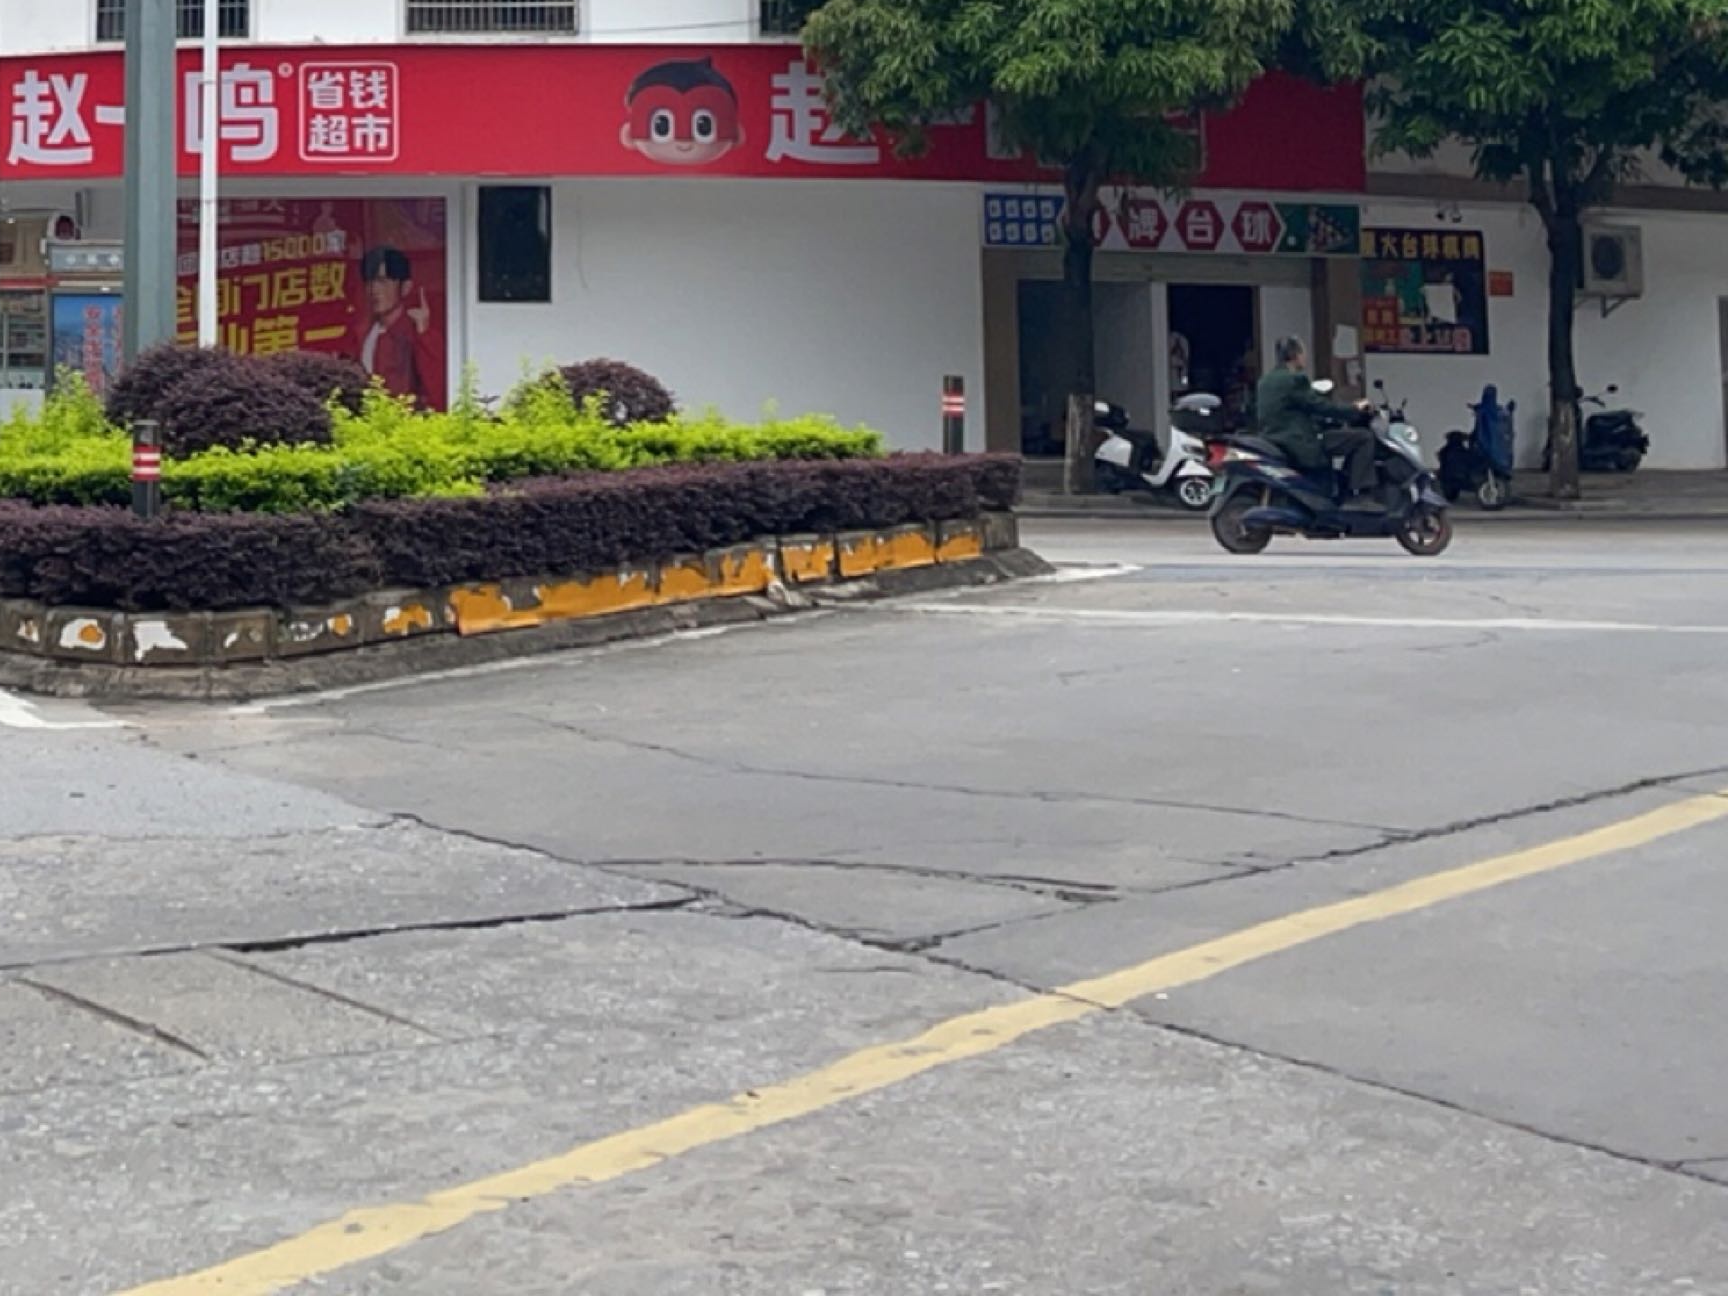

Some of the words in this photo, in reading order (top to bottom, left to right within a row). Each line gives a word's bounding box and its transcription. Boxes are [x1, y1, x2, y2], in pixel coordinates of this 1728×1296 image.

[307, 70, 388, 109] 省钱
[307, 114, 392, 154] 超市
[1093, 207, 1271, 243] 牌台球
